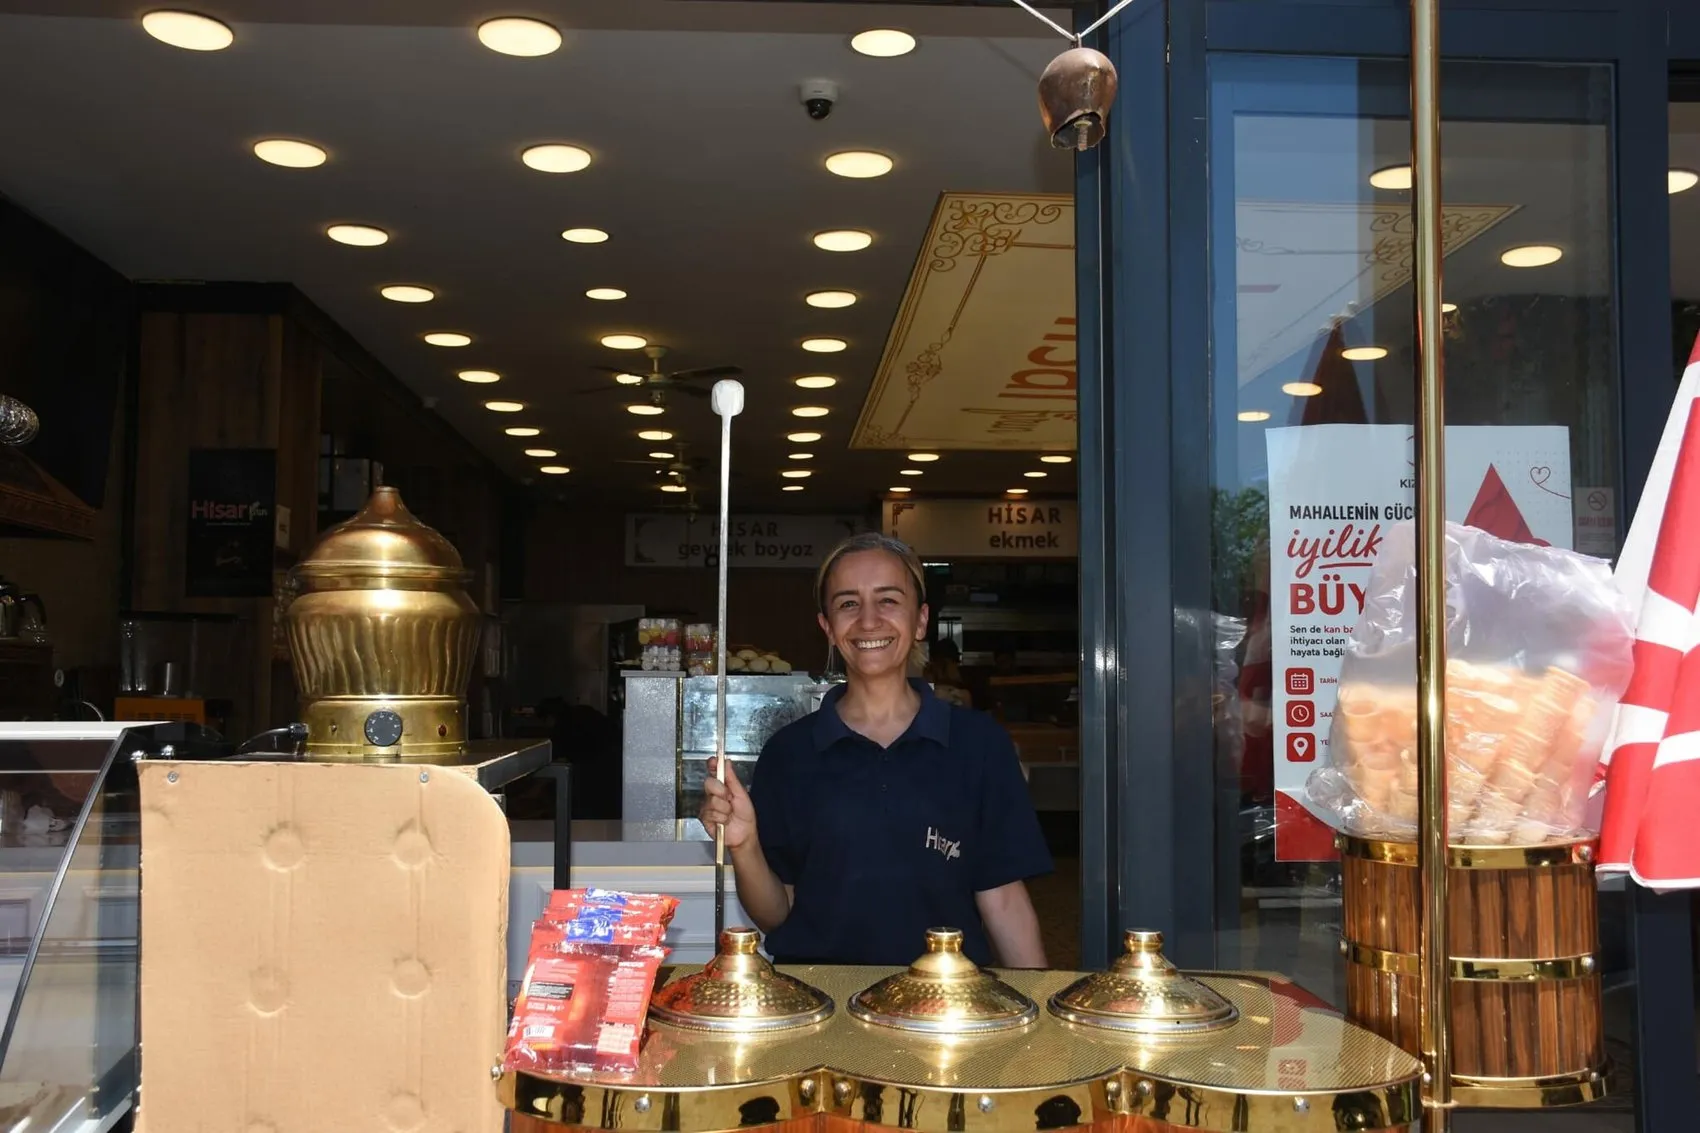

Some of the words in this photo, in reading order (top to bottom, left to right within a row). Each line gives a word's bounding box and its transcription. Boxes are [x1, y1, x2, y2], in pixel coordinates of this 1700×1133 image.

[988, 503, 1062, 524] HİSAR
[1289, 503, 1378, 520] MAHALLENİN
[1384, 503, 1416, 520] GÜC
[989, 532, 1060, 549] ekmek
[757, 541, 818, 562] boyoz
[1287, 524, 1383, 579] iyilik
[1290, 625, 1307, 634] Sen
[1310, 625, 1321, 634] de
[1324, 625, 1340, 634] kan
[1290, 637, 1323, 647] ihtiyacı
[1326, 637, 1345, 645] olan
[1290, 648, 1321, 658] hayata
